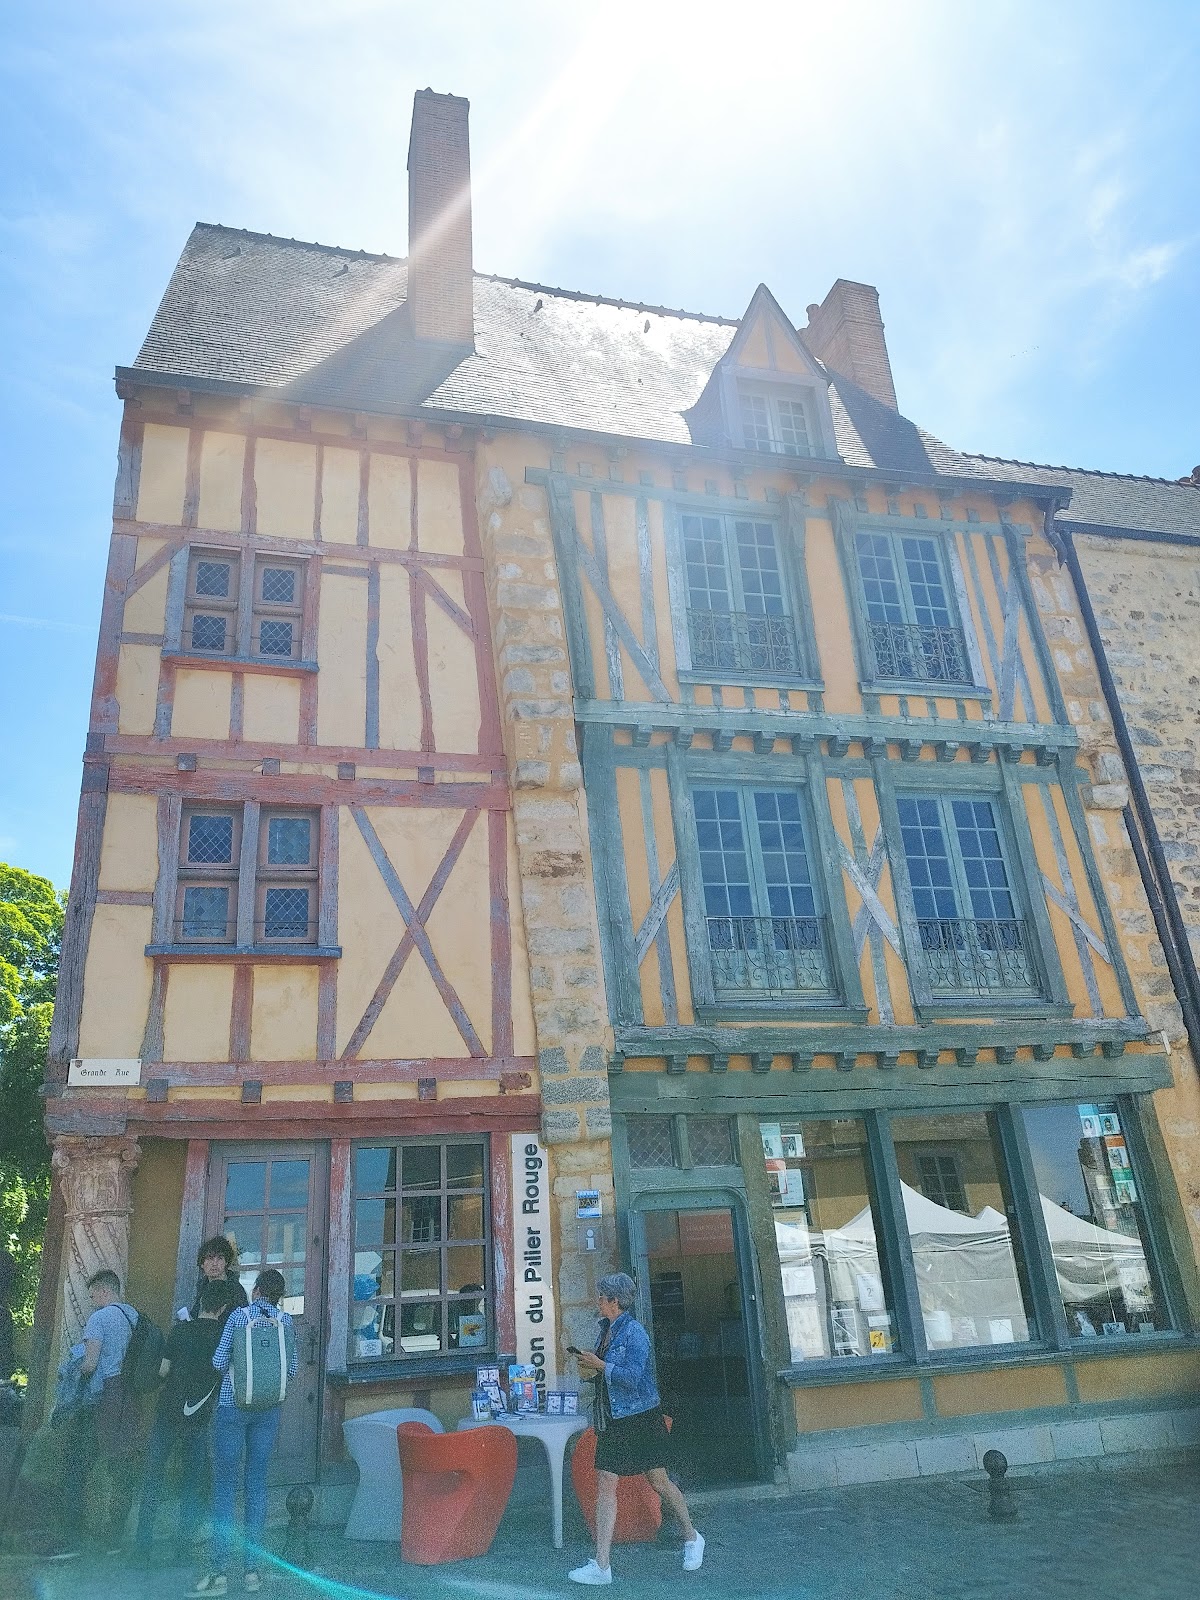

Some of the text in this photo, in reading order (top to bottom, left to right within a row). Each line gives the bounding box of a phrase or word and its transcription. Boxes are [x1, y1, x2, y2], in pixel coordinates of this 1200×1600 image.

[81, 1068, 130, 1077] Grande Rue
[522, 1143, 542, 1214] Rouge
[524, 1226, 542, 1283] Pilier
[526, 1294, 544, 1323] du
